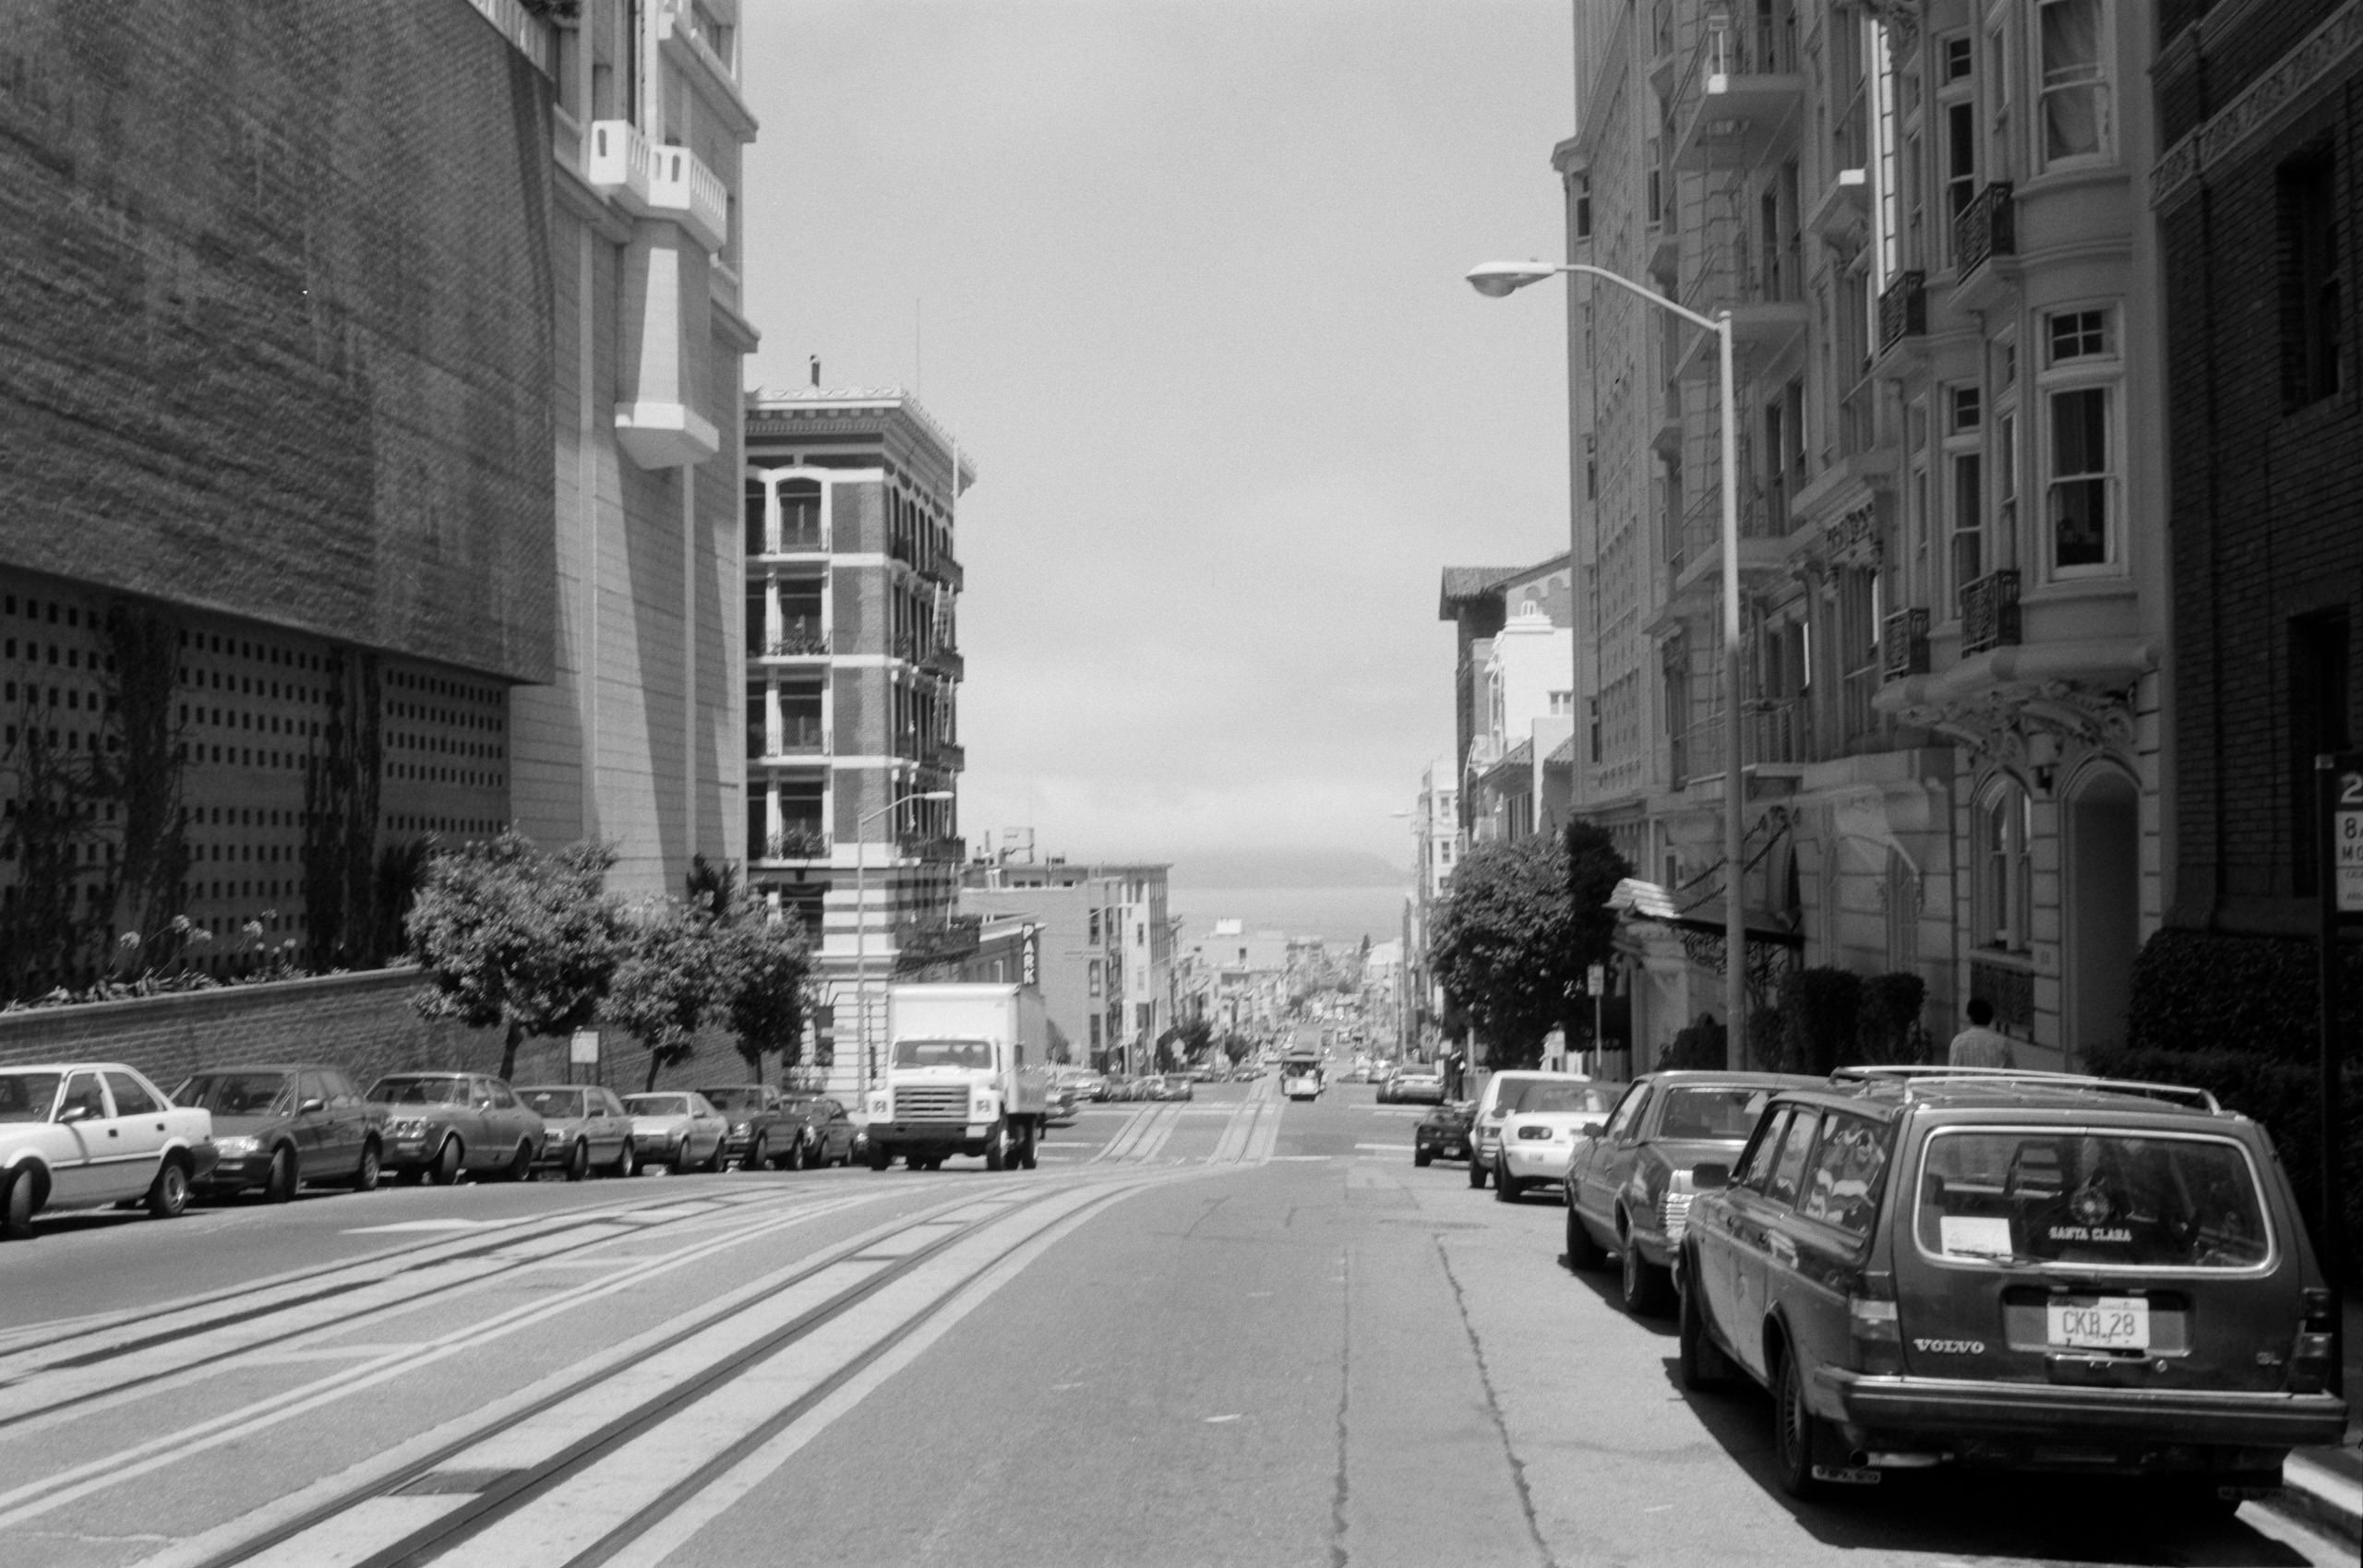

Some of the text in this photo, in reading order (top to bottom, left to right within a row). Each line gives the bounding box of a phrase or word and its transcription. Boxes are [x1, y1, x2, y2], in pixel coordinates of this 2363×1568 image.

[2341, 772, 2363, 803] 2
[1023, 925, 1036, 985] PARK
[2048, 1226, 2132, 1242] SANTA CLARA
[1913, 1338, 1985, 1355] VOLVO
